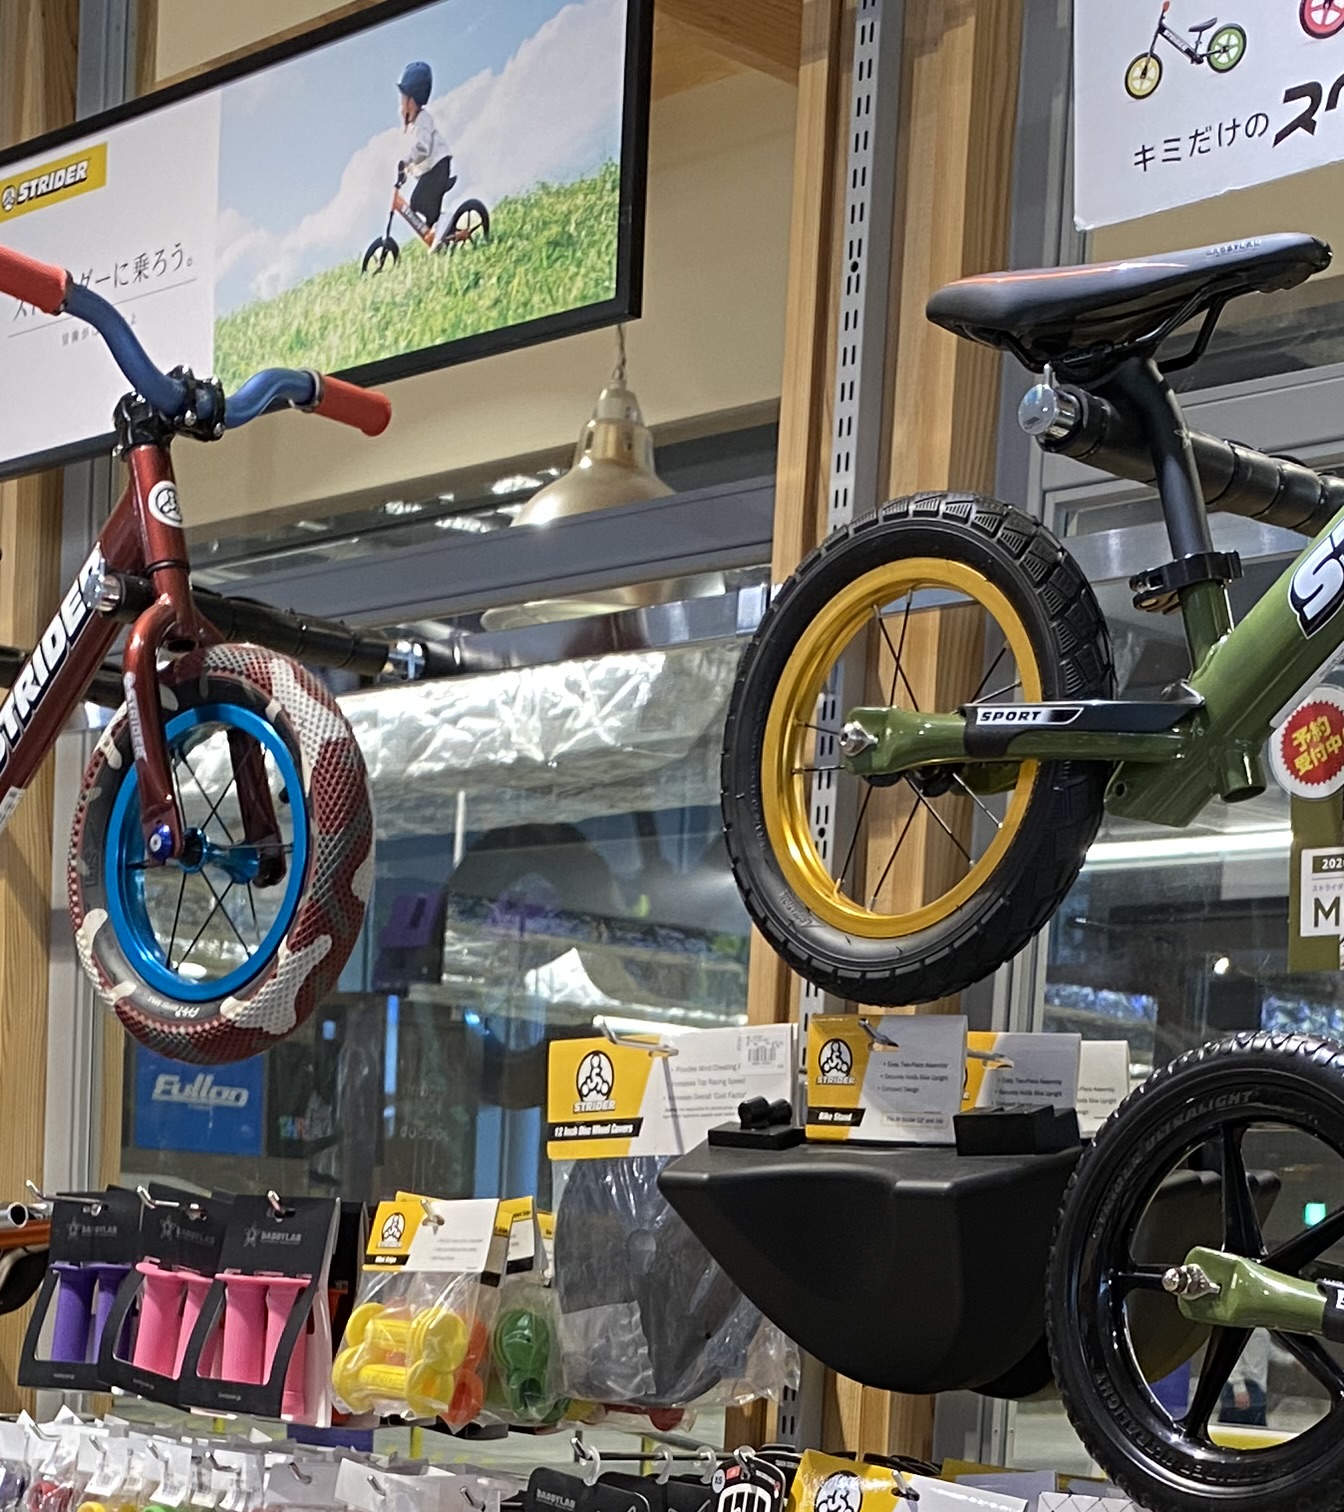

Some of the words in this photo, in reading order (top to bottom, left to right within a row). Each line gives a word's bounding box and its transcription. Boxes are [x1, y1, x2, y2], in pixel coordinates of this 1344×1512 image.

[1132, 112, 1270, 172] キミだけの
[16, 160, 89, 204] STRIDER
[980, 710, 1042, 723] SPORT
[1291, 714, 1332, 751] 予約
[815, 1075, 856, 1085] STRIDER
[573, 1100, 617, 1114] STRIDER
[818, 1111, 831, 1122] Bike
[833, 1111, 852, 1122] Stand
[564, 1127, 577, 1137] Inch
[593, 1125, 609, 1136] Wheel
[610, 1123, 633, 1135] Covers
[536, 1489, 577, 1509] DADDYLAB
